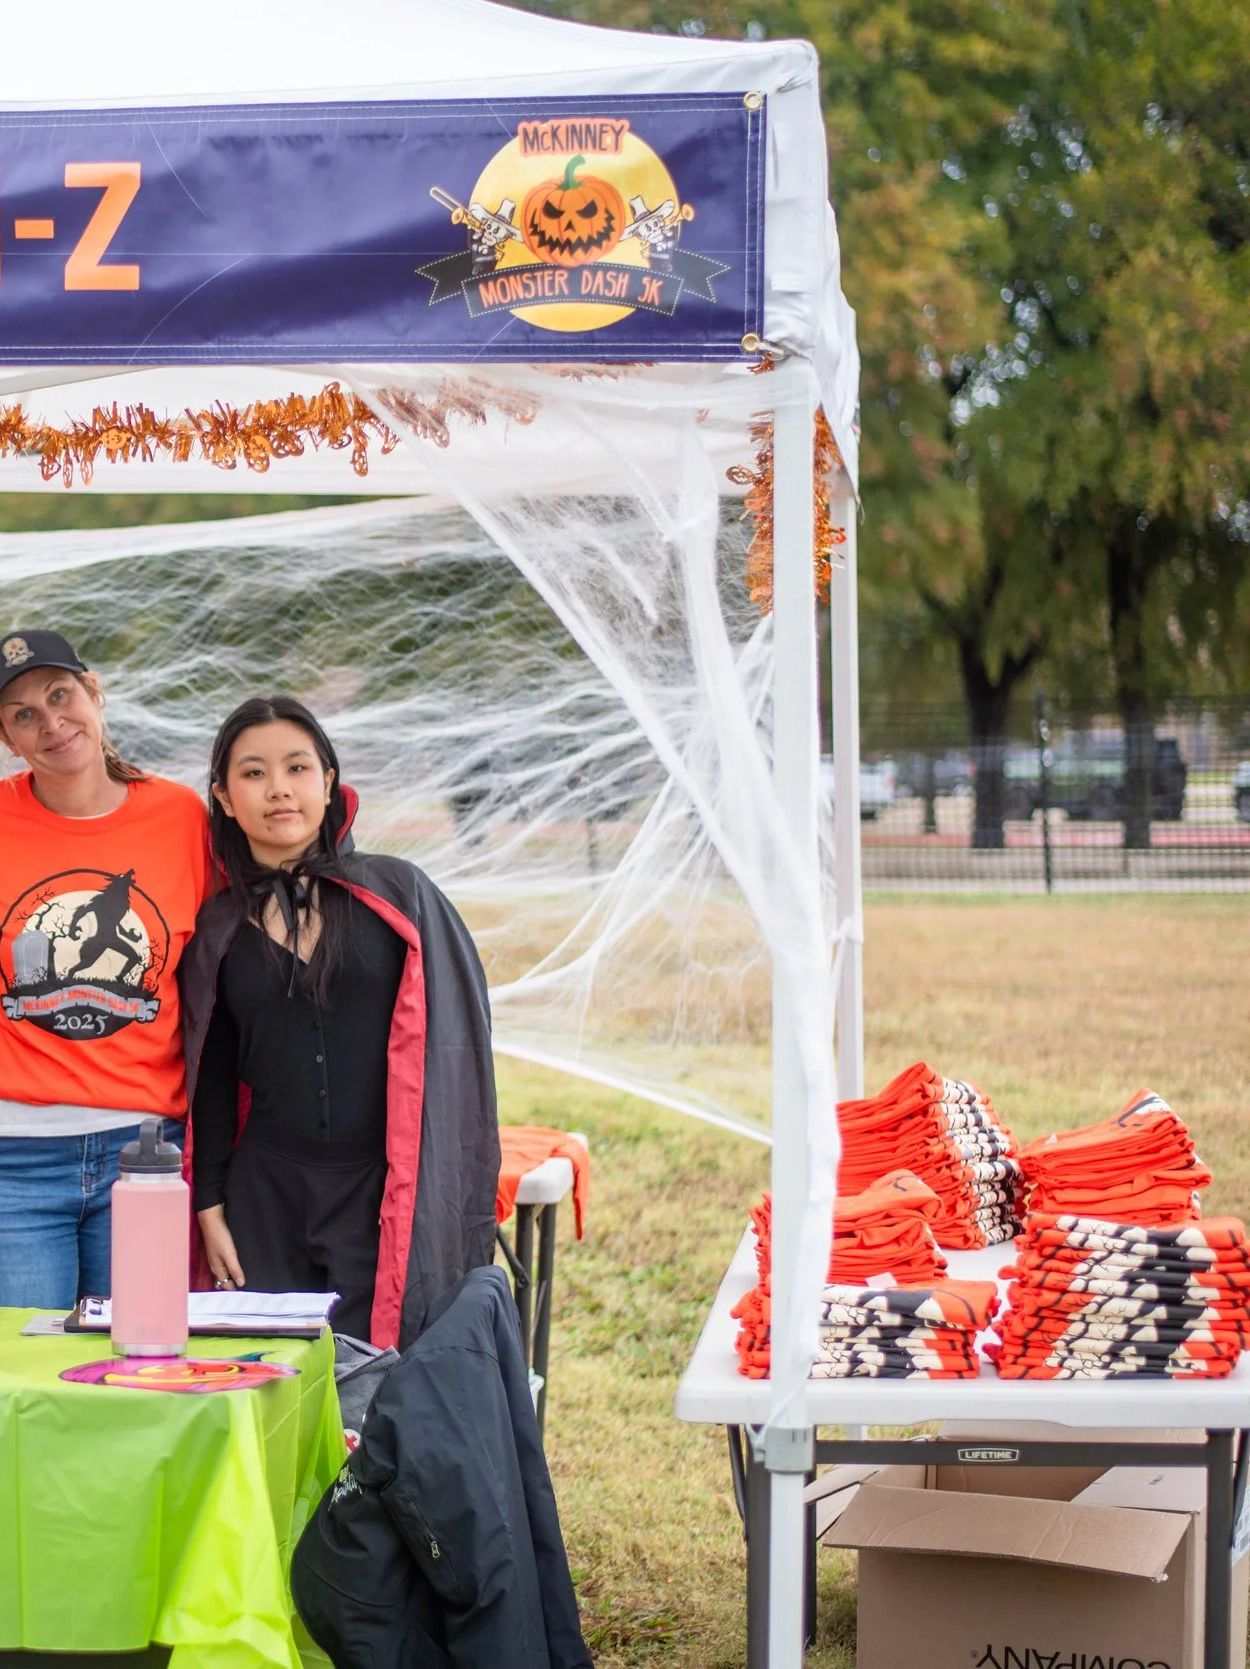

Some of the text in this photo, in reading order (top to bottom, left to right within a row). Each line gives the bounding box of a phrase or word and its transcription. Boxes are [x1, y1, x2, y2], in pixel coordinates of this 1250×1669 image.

[478, 268, 664, 308] MONSTER DASH 5K
[53, 1013, 109, 1035] 2025
[964, 1451, 1013, 1459] LIFETIME
